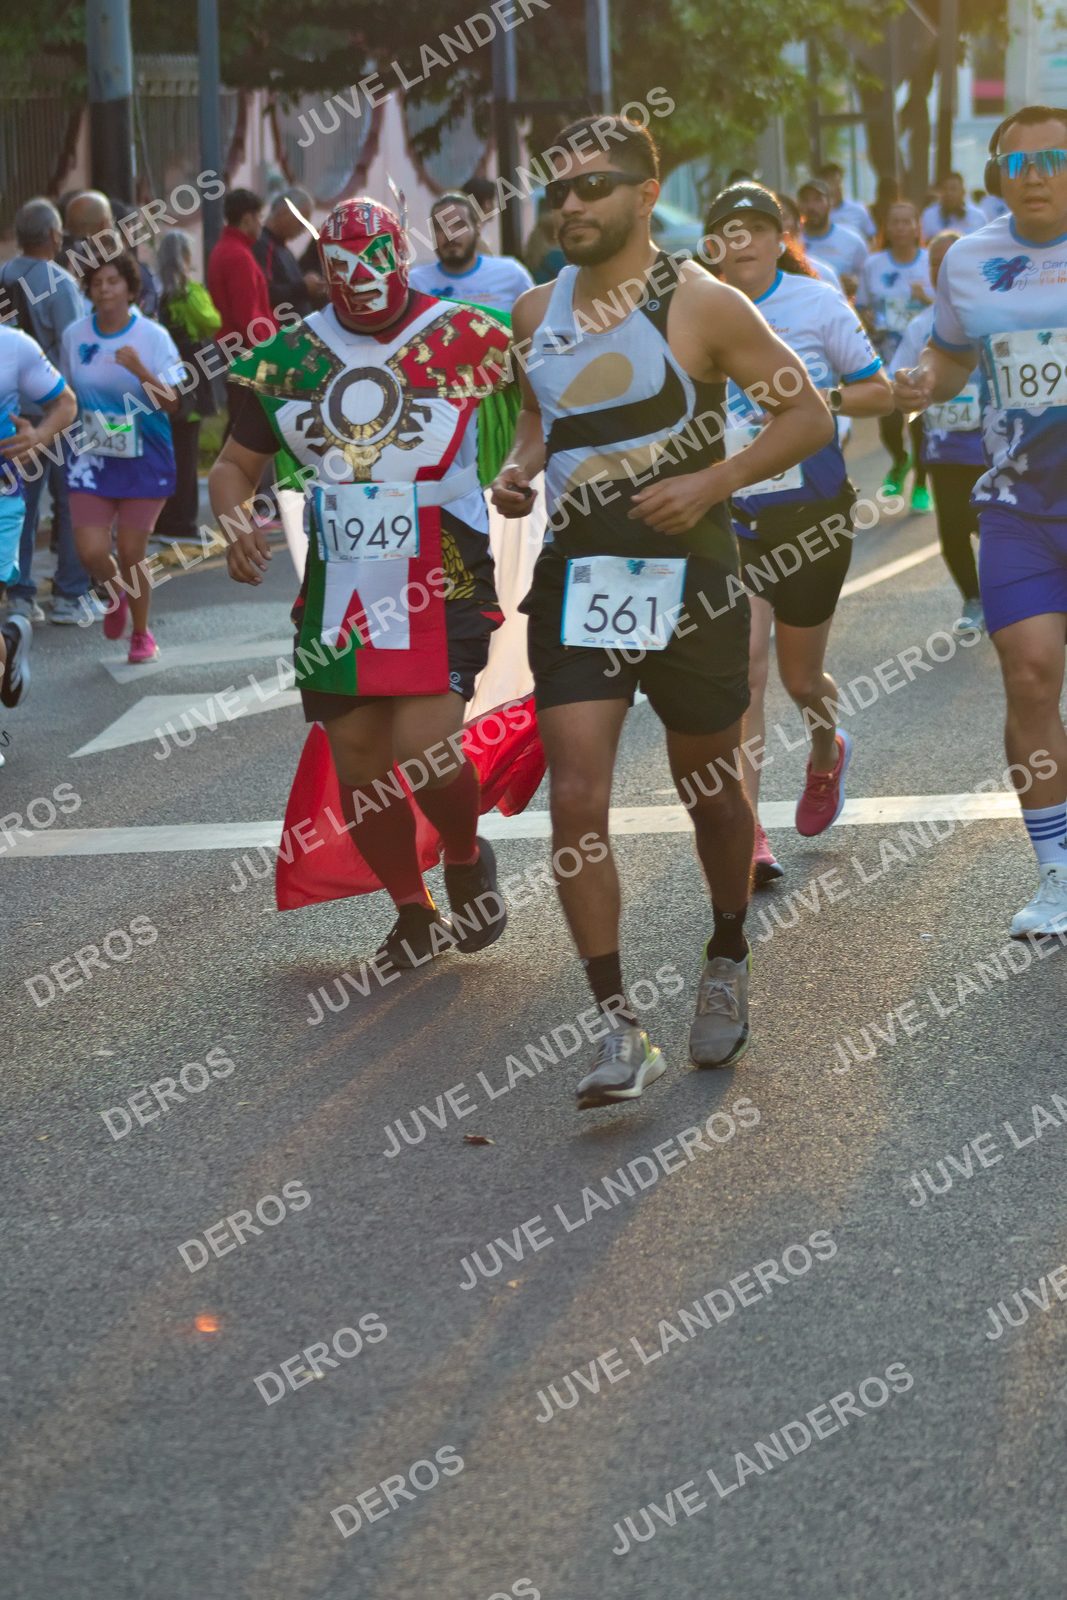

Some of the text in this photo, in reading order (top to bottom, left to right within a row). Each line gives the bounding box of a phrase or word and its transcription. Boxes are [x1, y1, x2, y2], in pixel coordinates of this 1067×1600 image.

[1001, 362, 1067, 398] 189
[328, 515, 412, 551] 1949
[583, 594, 657, 634] 561
